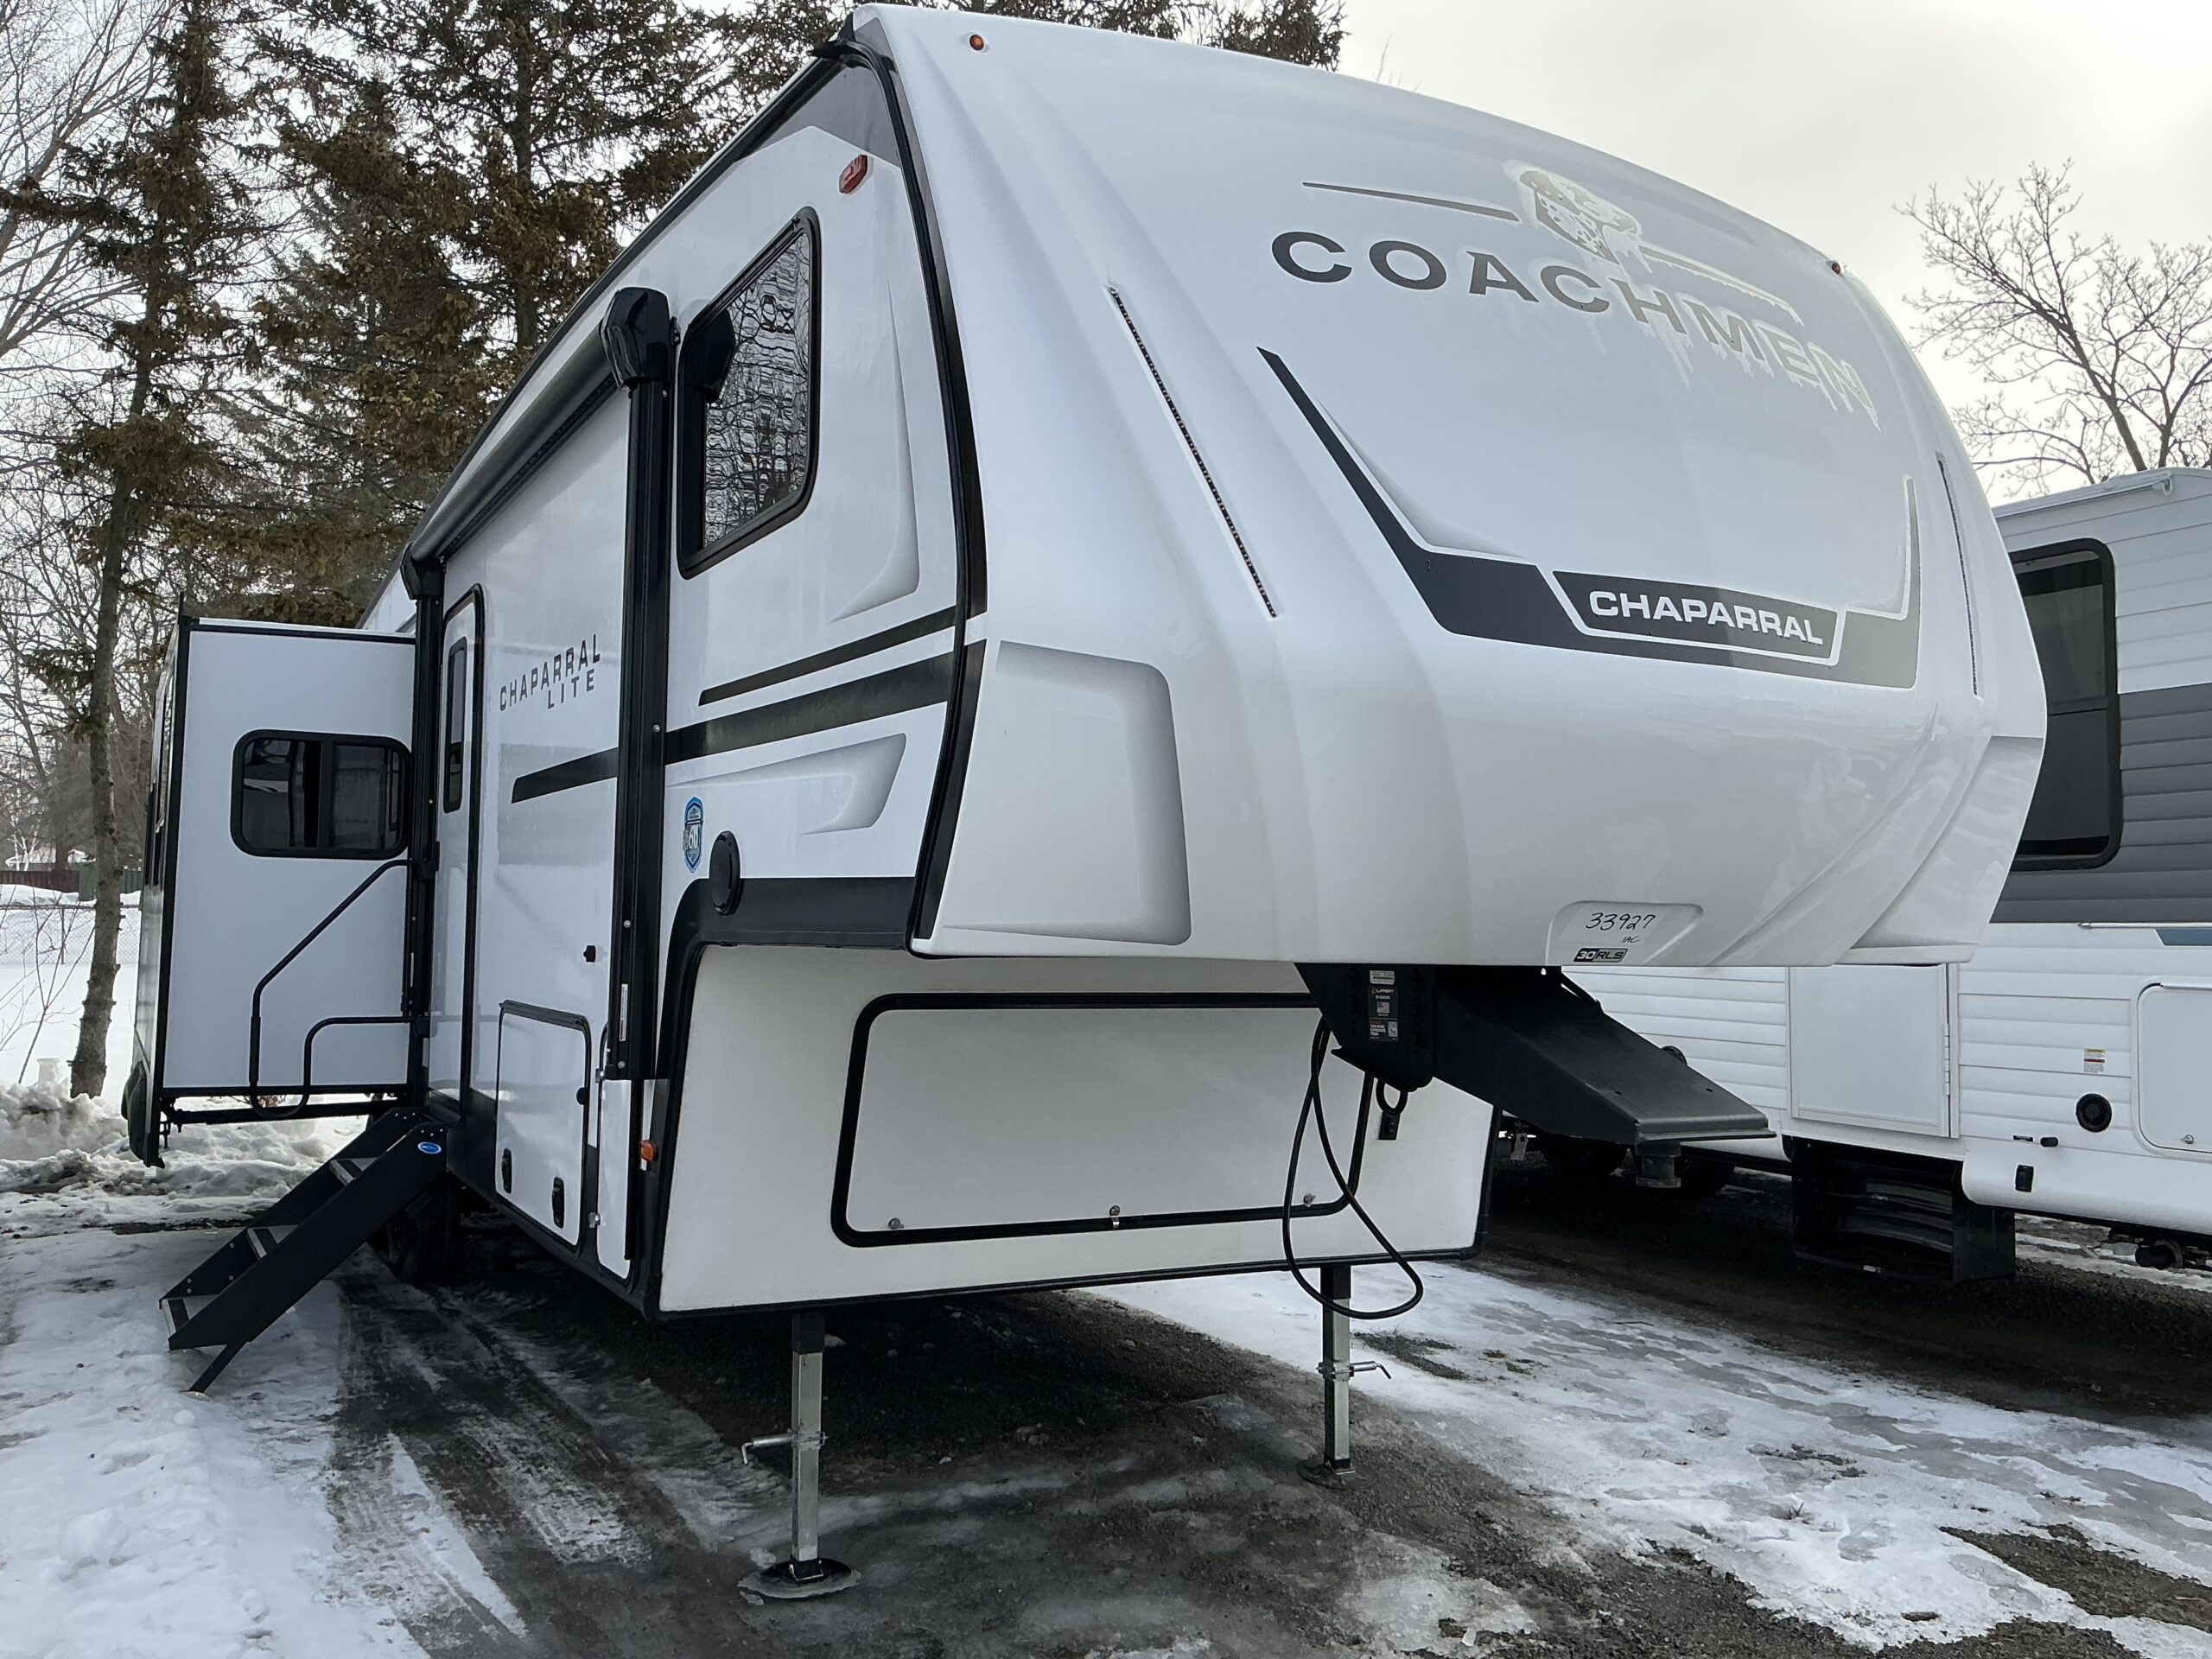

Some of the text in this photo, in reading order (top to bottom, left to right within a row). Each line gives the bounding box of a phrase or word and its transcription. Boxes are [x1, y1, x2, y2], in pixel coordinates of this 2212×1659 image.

[1271, 231, 1874, 410] COACHMEN
[1588, 590, 1823, 645] CHAPARRAL
[499, 633, 601, 711] CHAPARRAL
[547, 668, 594, 709] LITE
[1586, 912, 1656, 931] 33927
